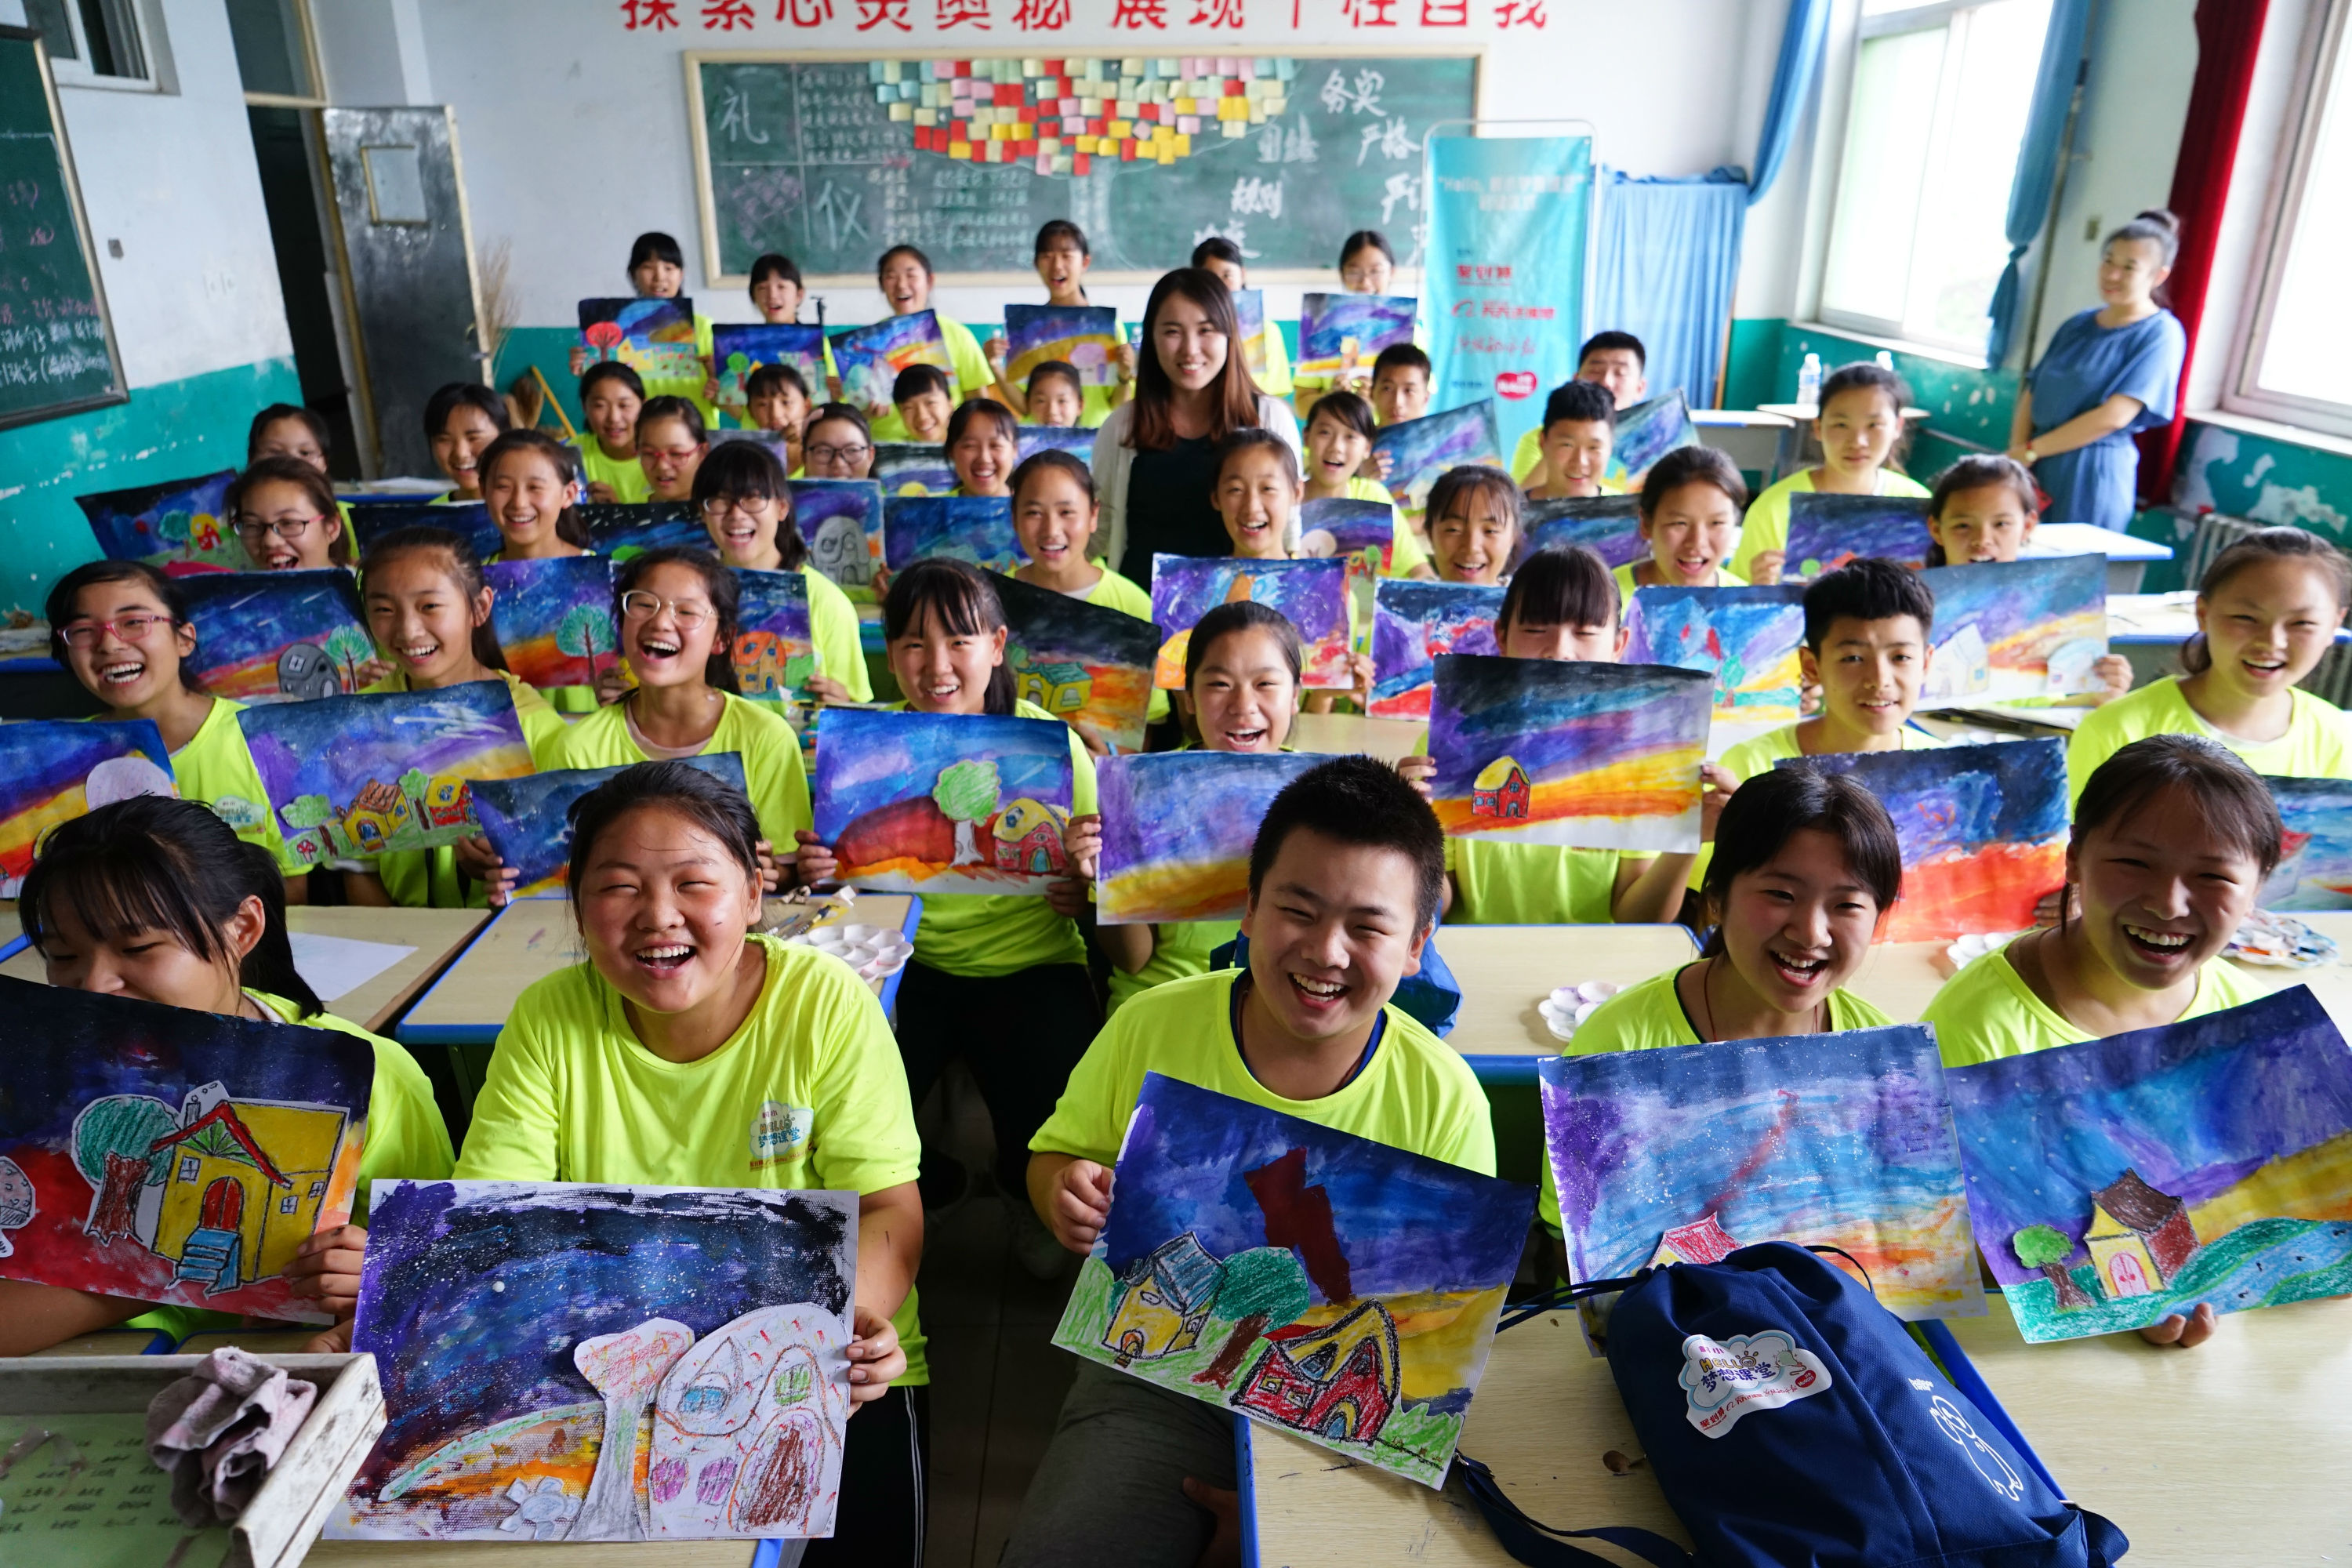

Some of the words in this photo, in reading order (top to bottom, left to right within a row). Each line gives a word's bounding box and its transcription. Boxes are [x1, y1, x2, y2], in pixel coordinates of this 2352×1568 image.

[720, 85, 770, 144] 礼
[814, 179, 869, 251] 仪
[758, 1127, 800, 1149] 梦想课堂
[1700, 1362, 1776, 1393] 梦想课堂
